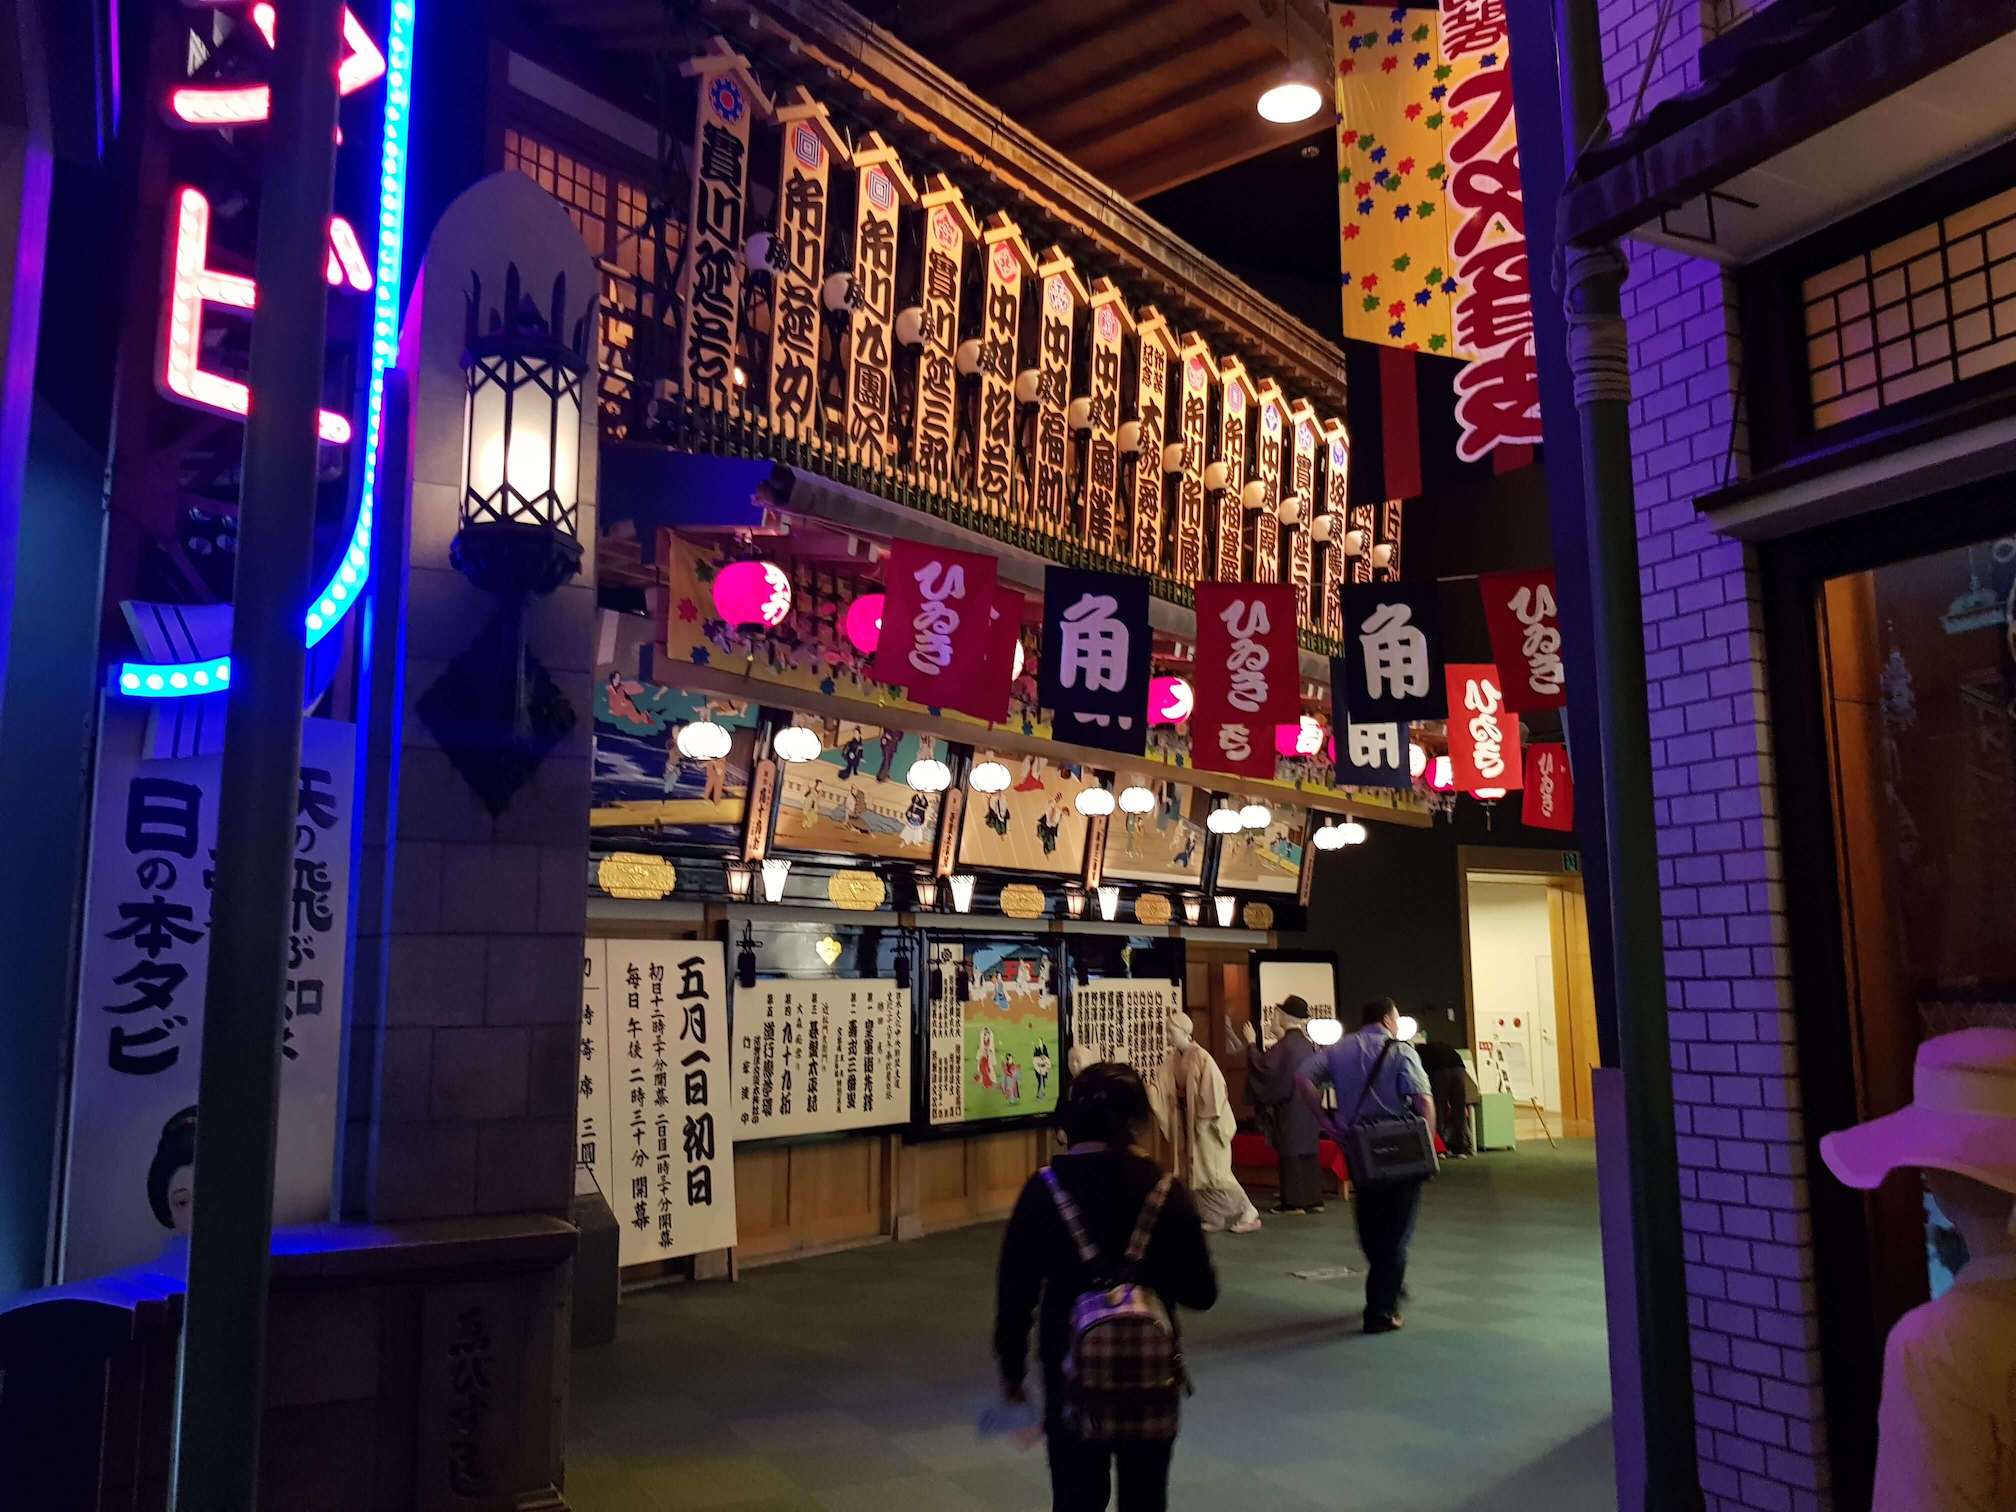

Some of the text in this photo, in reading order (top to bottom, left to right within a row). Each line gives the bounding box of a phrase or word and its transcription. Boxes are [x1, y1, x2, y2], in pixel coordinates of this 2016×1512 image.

[1060, 592, 1129, 693] 角
[1359, 602, 1430, 700] 角
[102, 777, 204, 1076] 日の本タビ
[676, 956, 716, 1207] 五月一日初日
